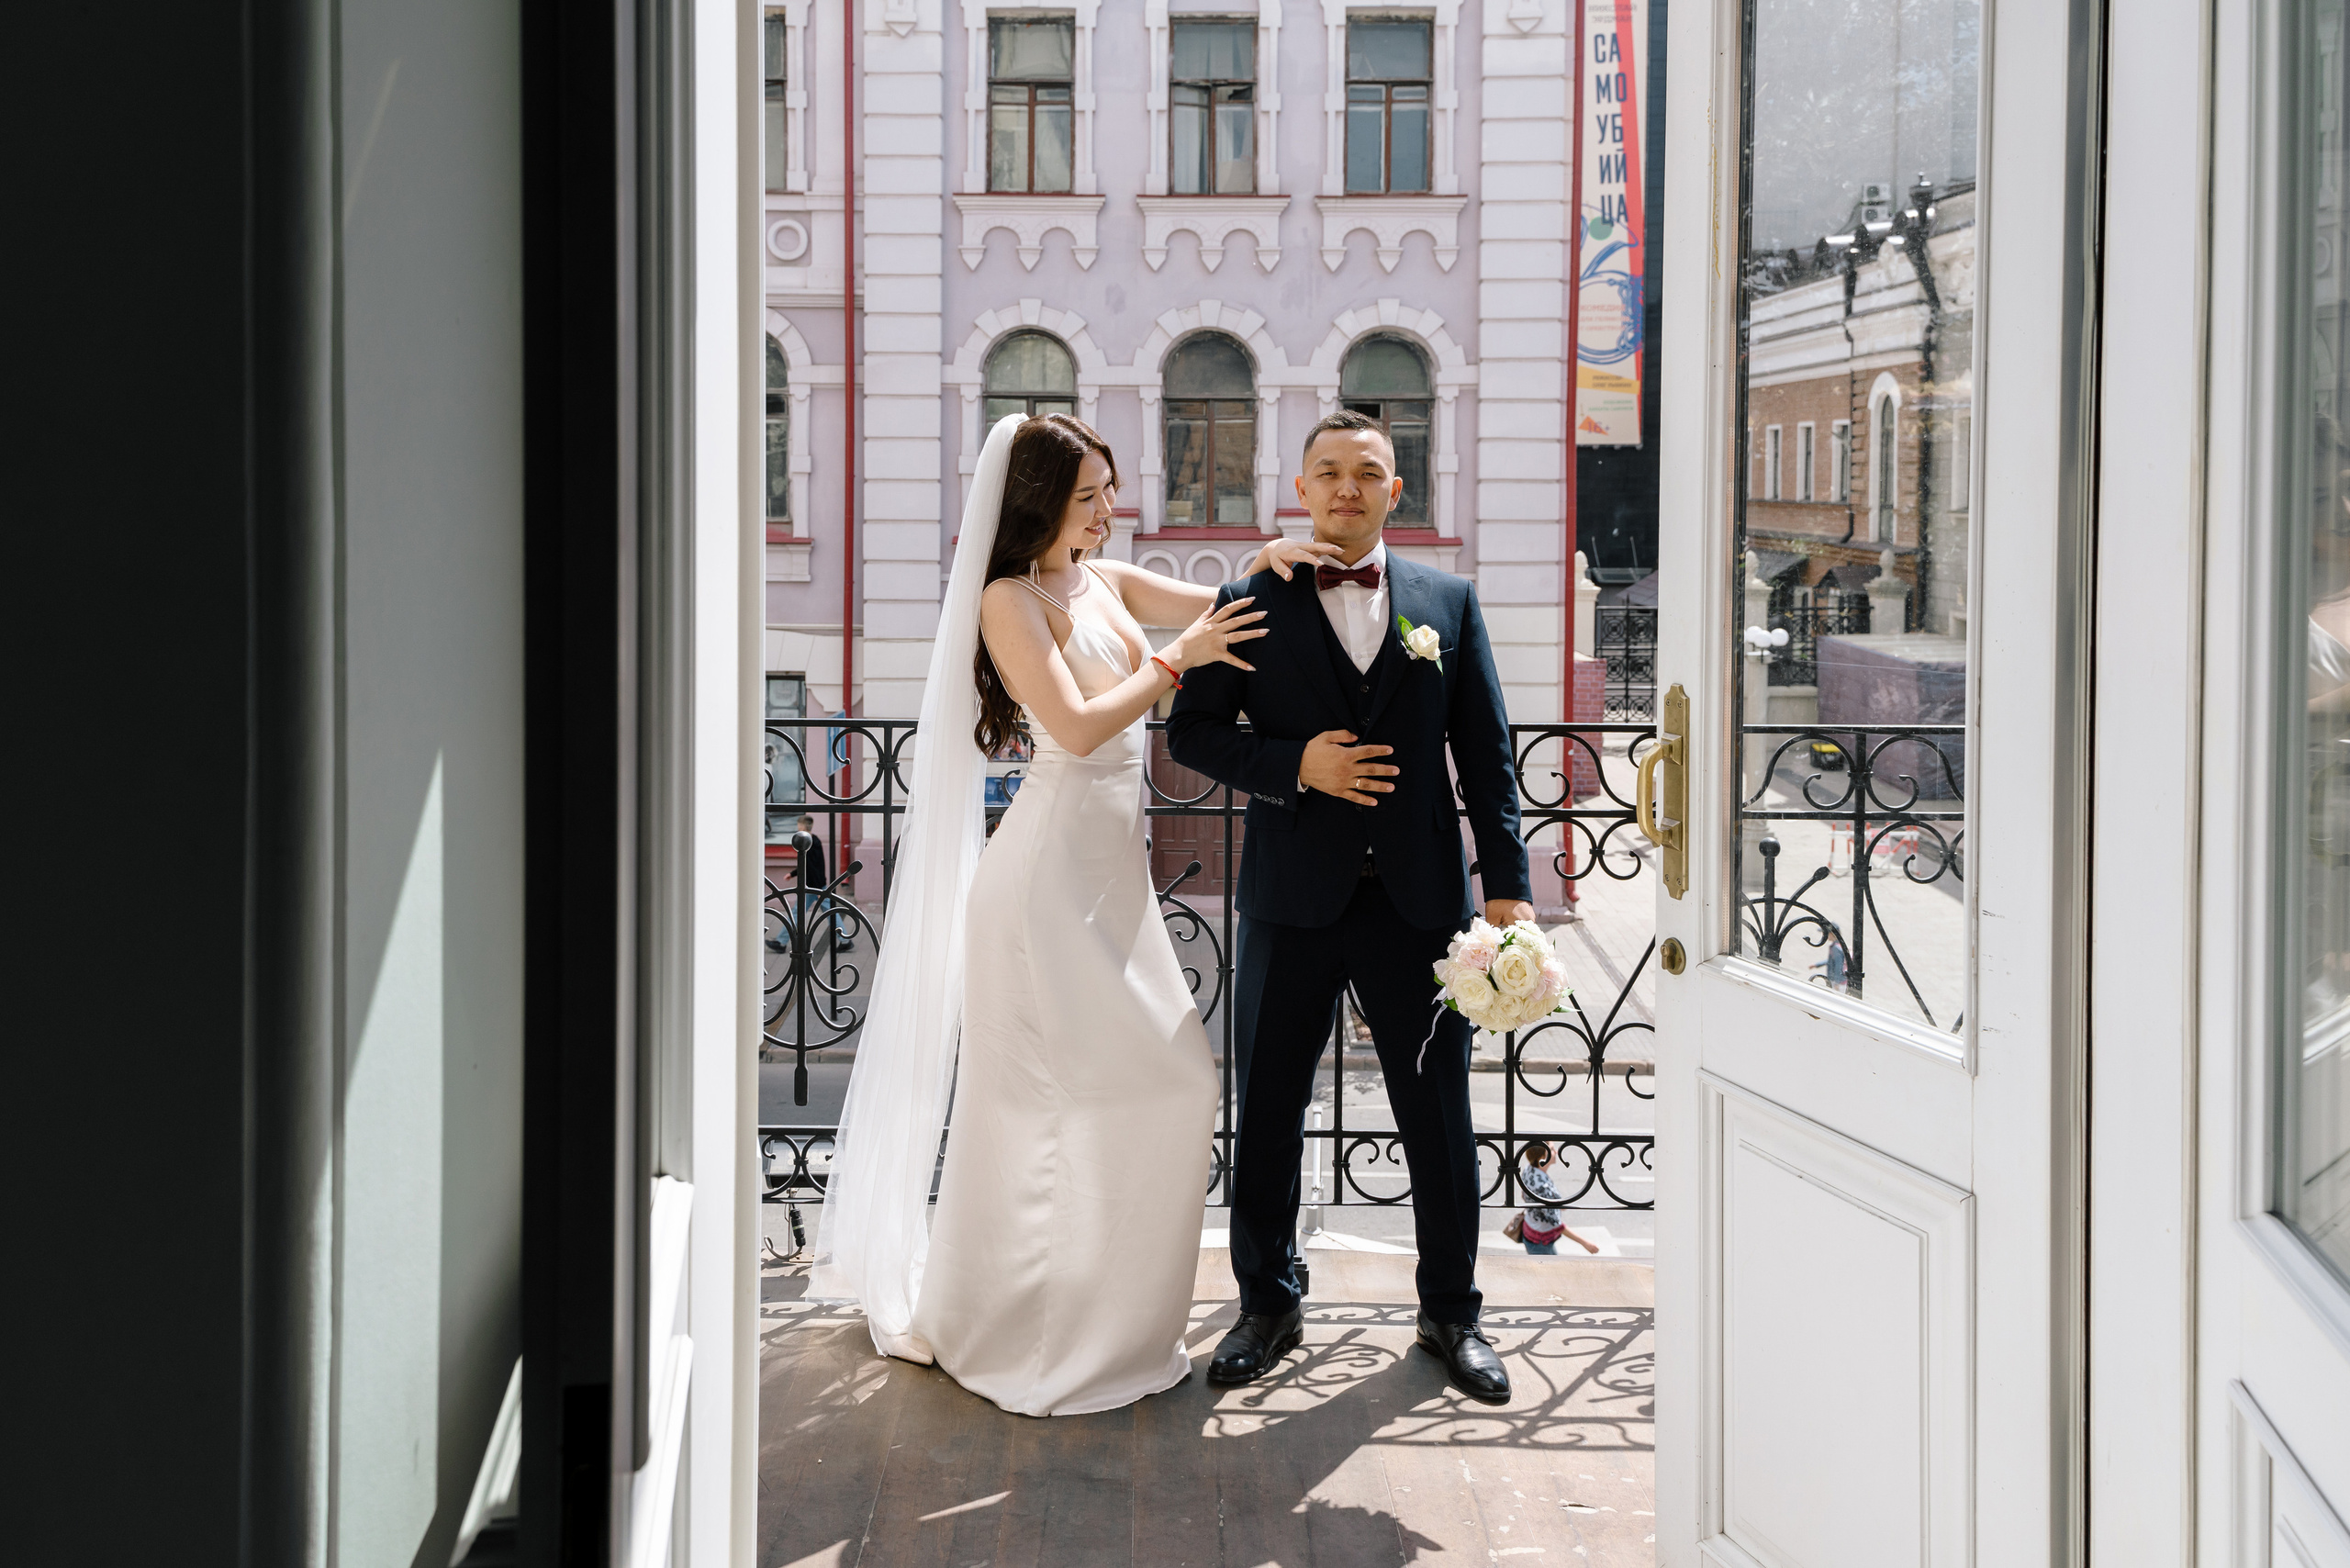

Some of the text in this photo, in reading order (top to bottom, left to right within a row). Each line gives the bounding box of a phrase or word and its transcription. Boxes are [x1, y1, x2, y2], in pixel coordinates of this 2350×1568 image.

[1594, 33, 1621, 63] СА
[1595, 73, 1627, 104] МО
[1595, 113, 1624, 144] УБ
[1599, 148, 1628, 185] ИЙ
[1601, 194, 1628, 228] ЦА
